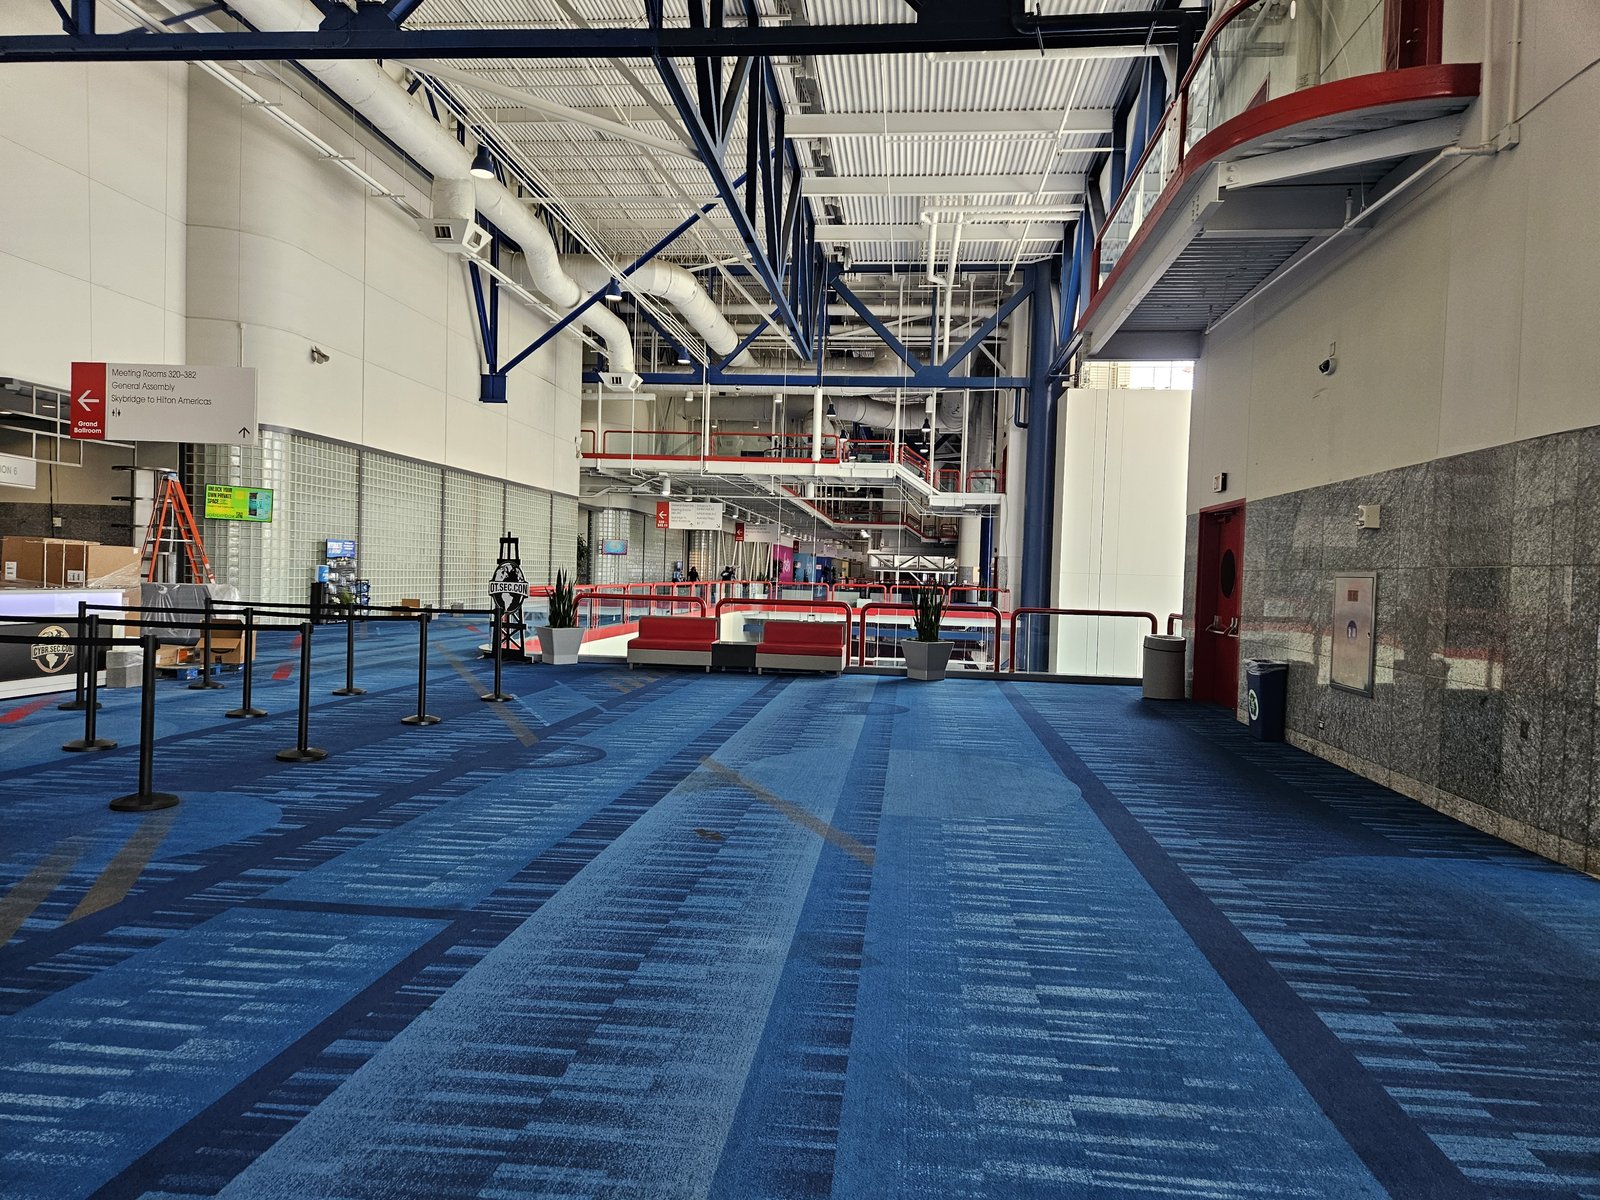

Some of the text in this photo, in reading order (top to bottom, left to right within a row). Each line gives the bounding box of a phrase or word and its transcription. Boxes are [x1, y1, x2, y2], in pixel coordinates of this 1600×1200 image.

[111, 368, 197, 379] Meeting Rooms 320-382
[111, 381, 176, 392] General Assembly
[111, 394, 212, 406] Skybridge to Hilton Americas
[13, 466, 18, 475] 6
[490, 582, 528, 594] OT.SEC.CON
